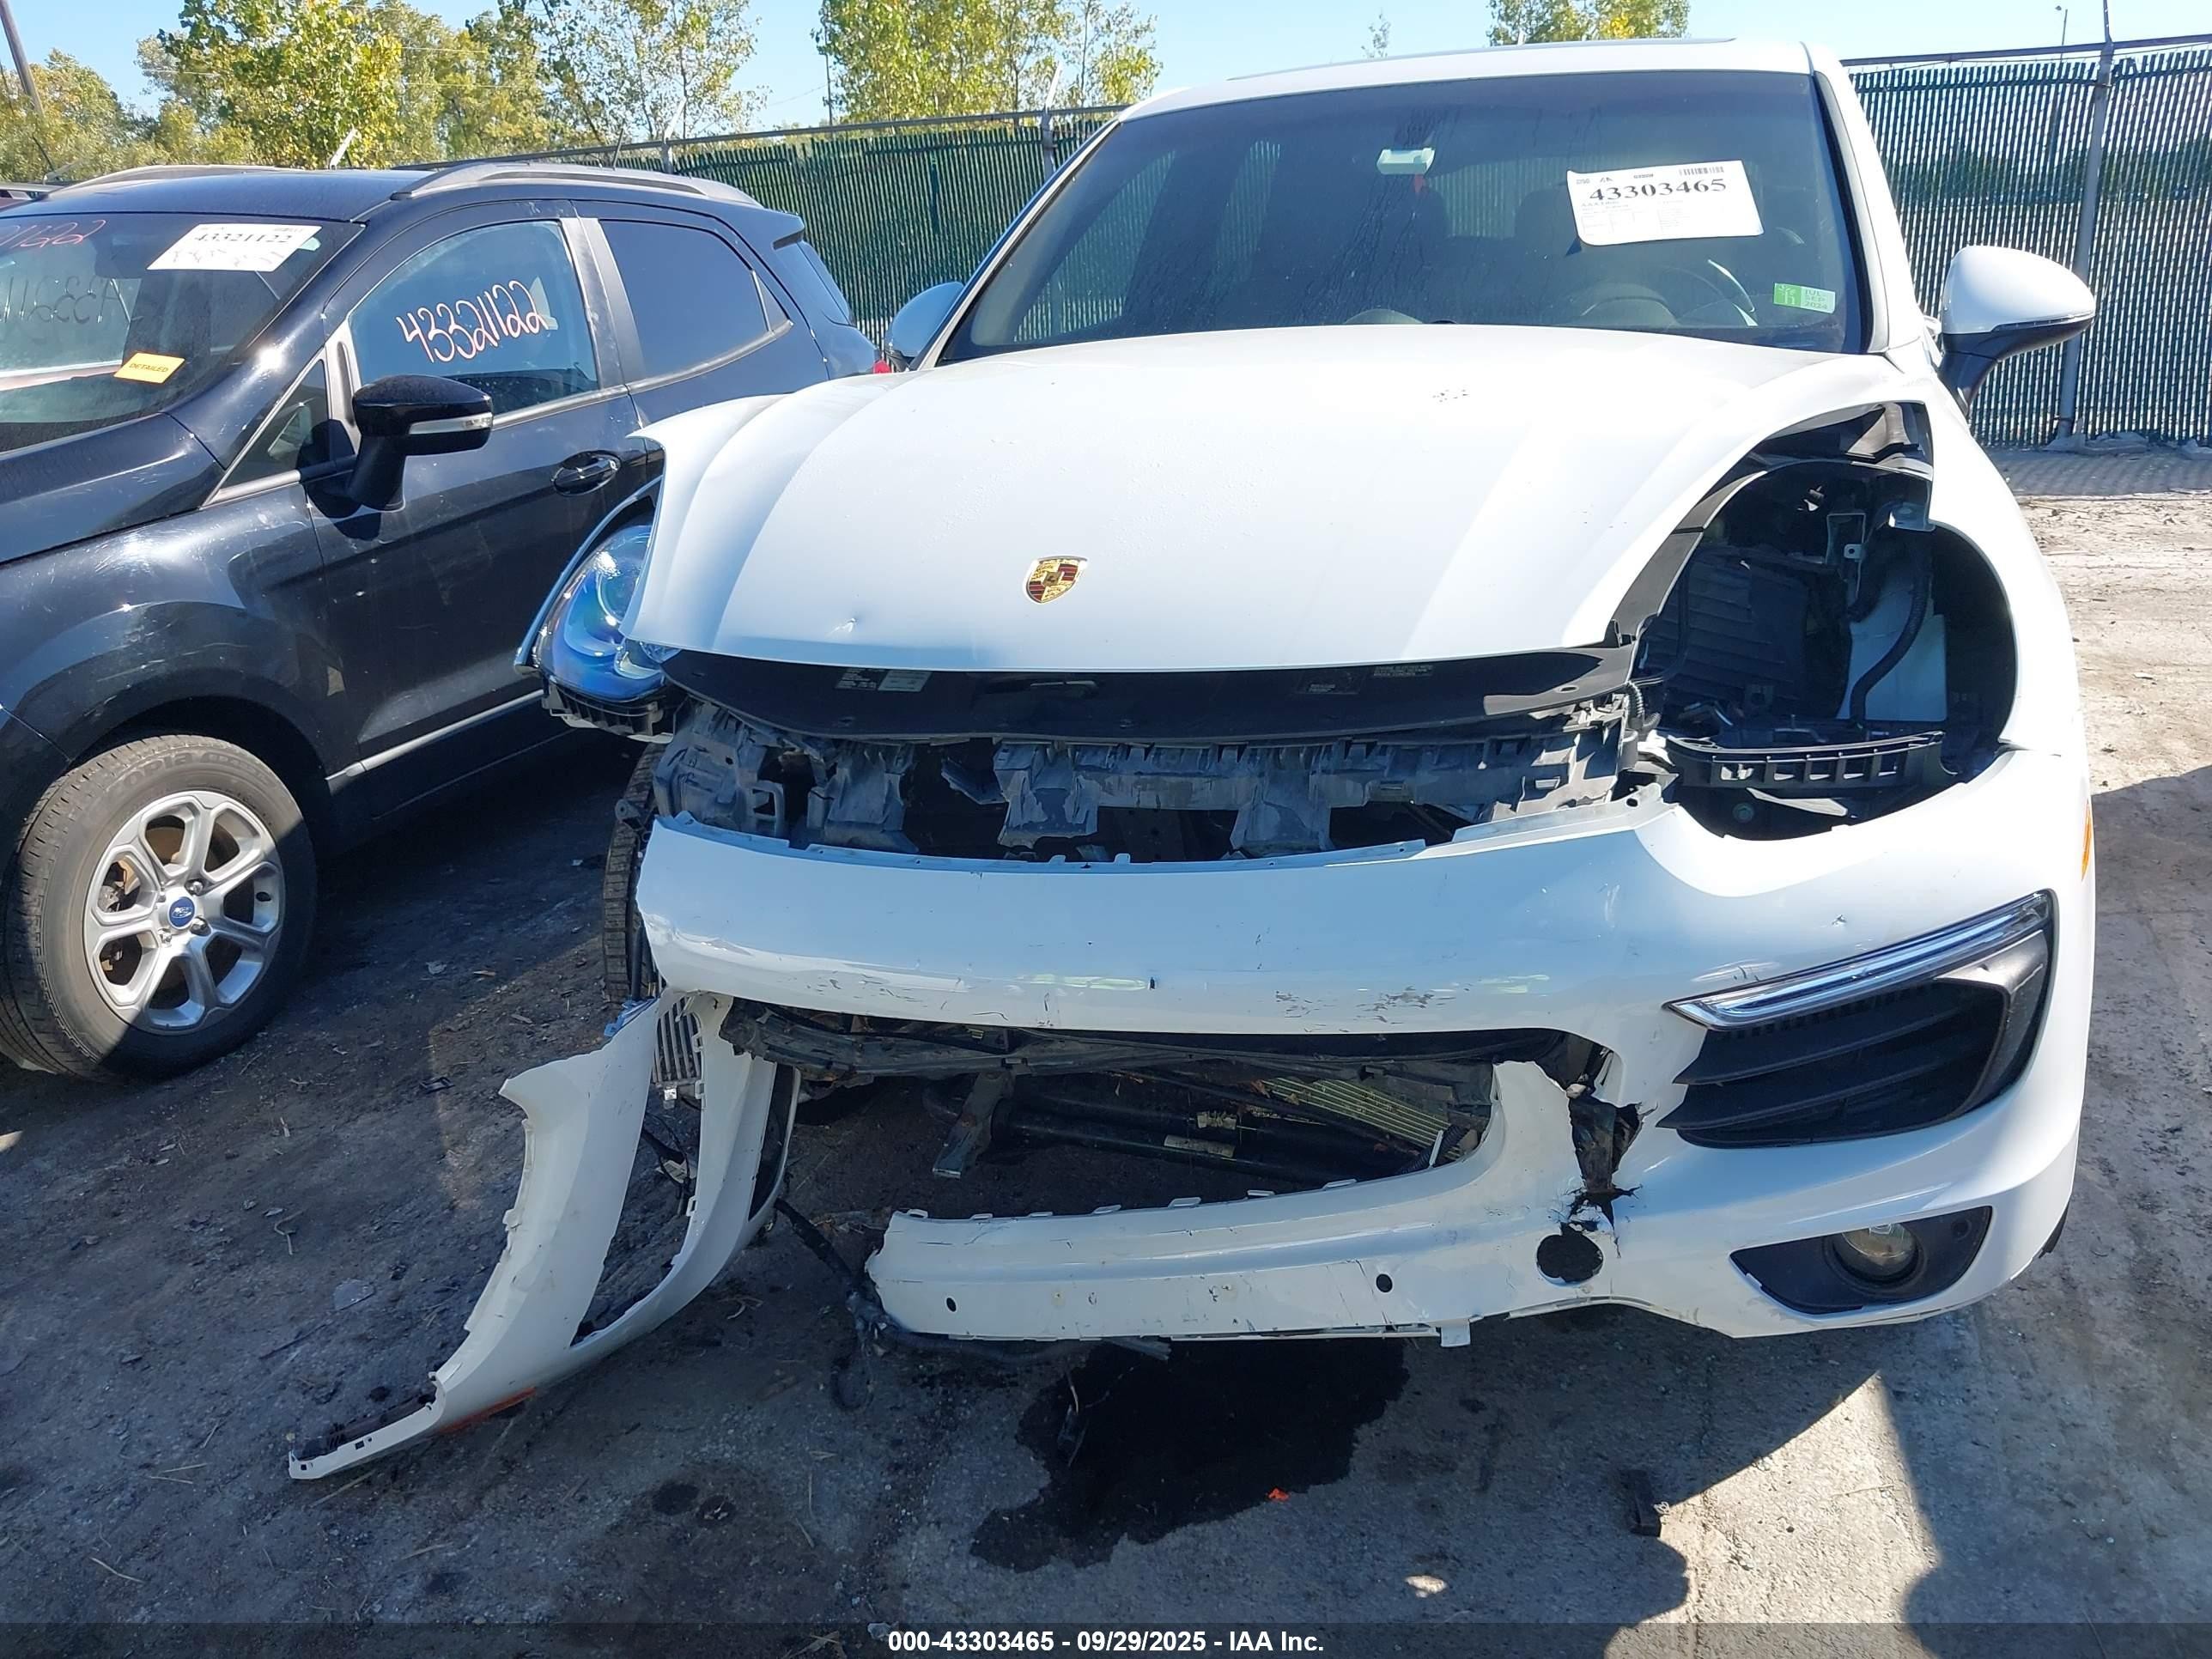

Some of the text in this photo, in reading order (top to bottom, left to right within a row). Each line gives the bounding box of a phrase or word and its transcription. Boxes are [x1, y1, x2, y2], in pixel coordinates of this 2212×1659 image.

[1589, 178, 1727, 201] 43303465
[395, 280, 550, 363] 43321122
[128, 362, 169, 373] DETAILED
